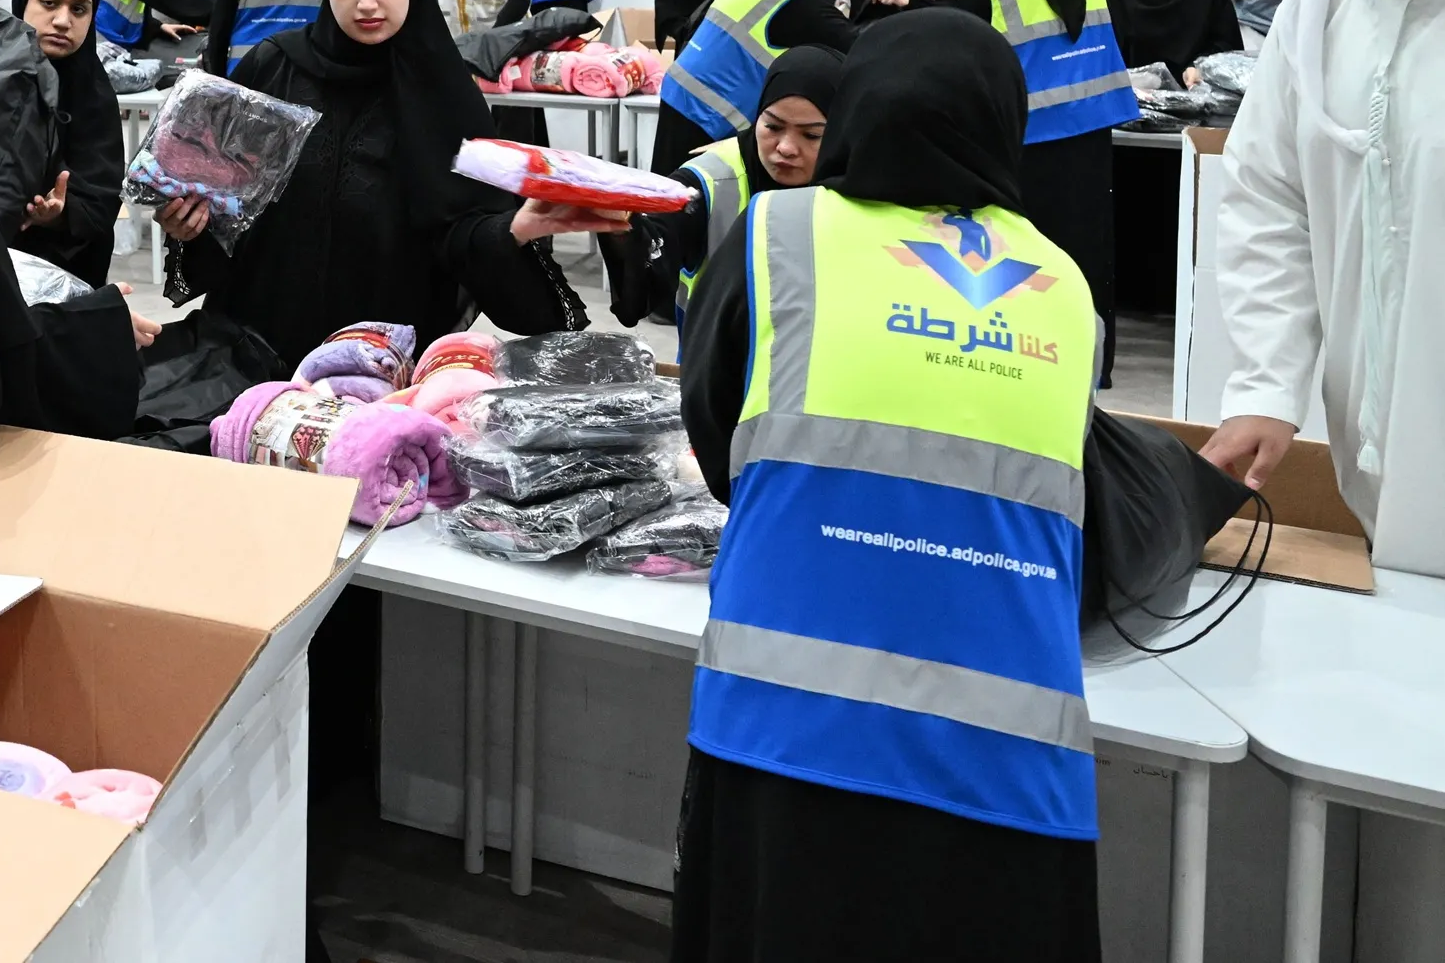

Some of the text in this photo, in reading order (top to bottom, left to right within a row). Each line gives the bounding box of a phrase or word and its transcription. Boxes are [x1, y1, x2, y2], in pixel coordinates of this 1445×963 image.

[886, 303, 1059, 365] كلنا شرطة
[925, 351, 1023, 380] WE ARE ALL POLICE
[820, 524, 1057, 580] weareallpolice.adpolice.gov.ae
